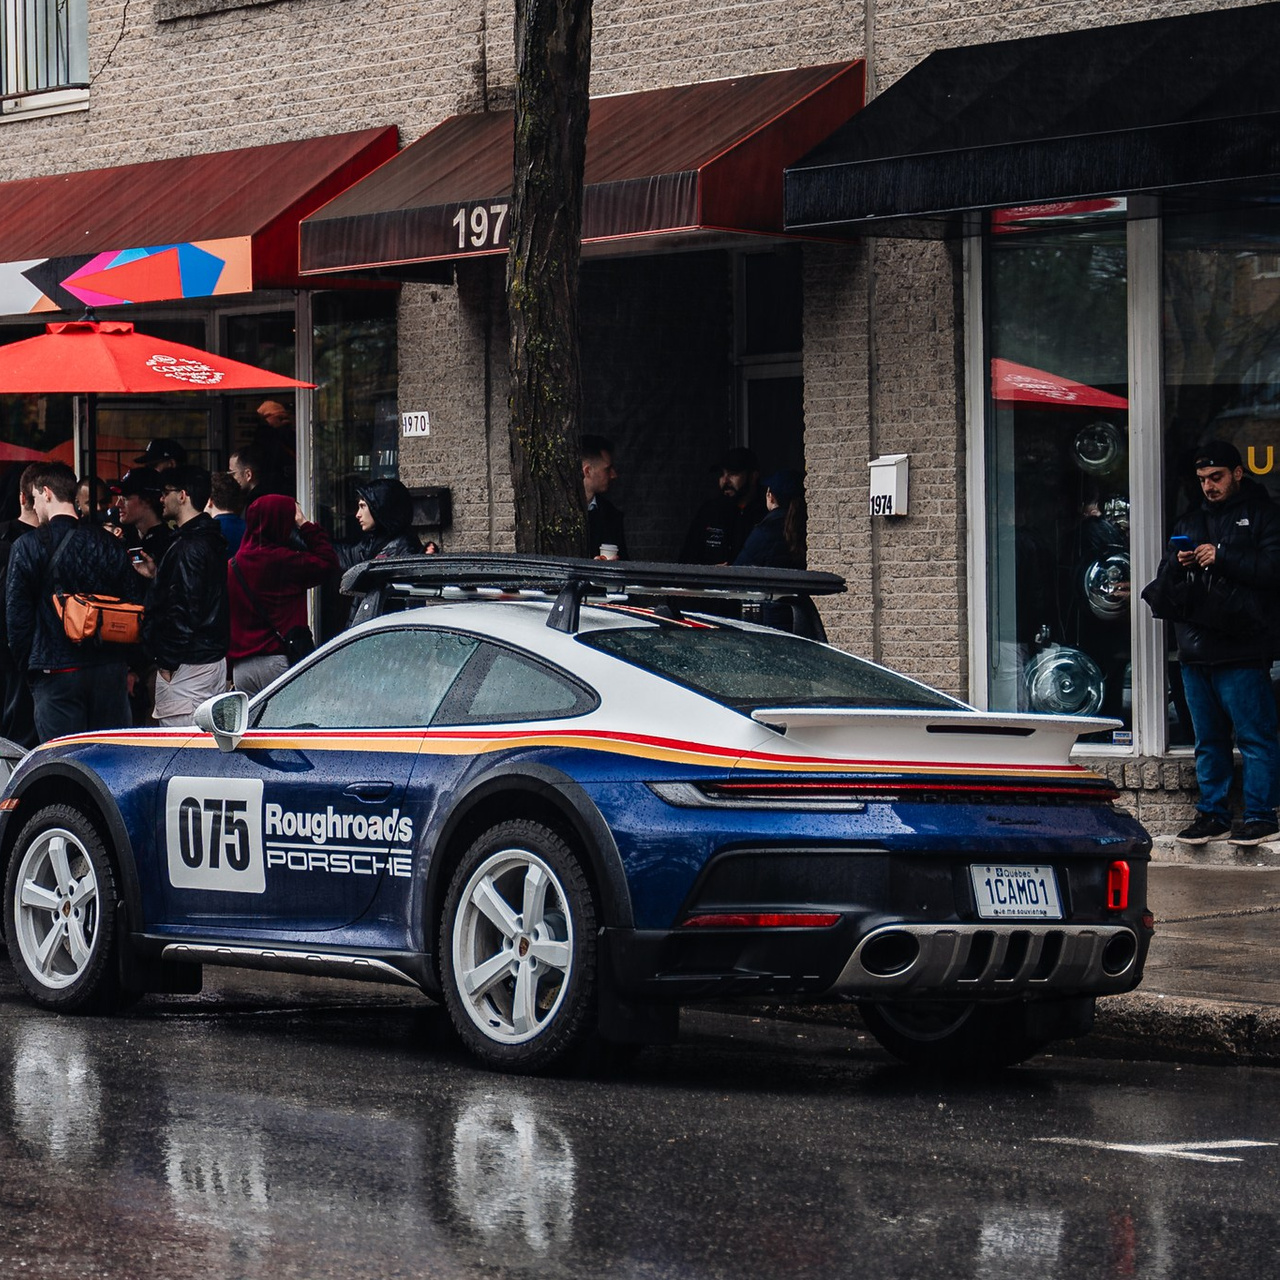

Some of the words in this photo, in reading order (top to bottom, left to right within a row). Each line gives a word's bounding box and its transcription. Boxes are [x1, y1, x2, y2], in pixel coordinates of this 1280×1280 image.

[403, 414, 426, 433] 1970
[871, 494, 893, 516] 1974
[178, 796, 251, 872] 075
[265, 803, 413, 844] Roughroads
[267, 850, 412, 878] PORSCHE
[1004, 868, 1032, 878] Québec
